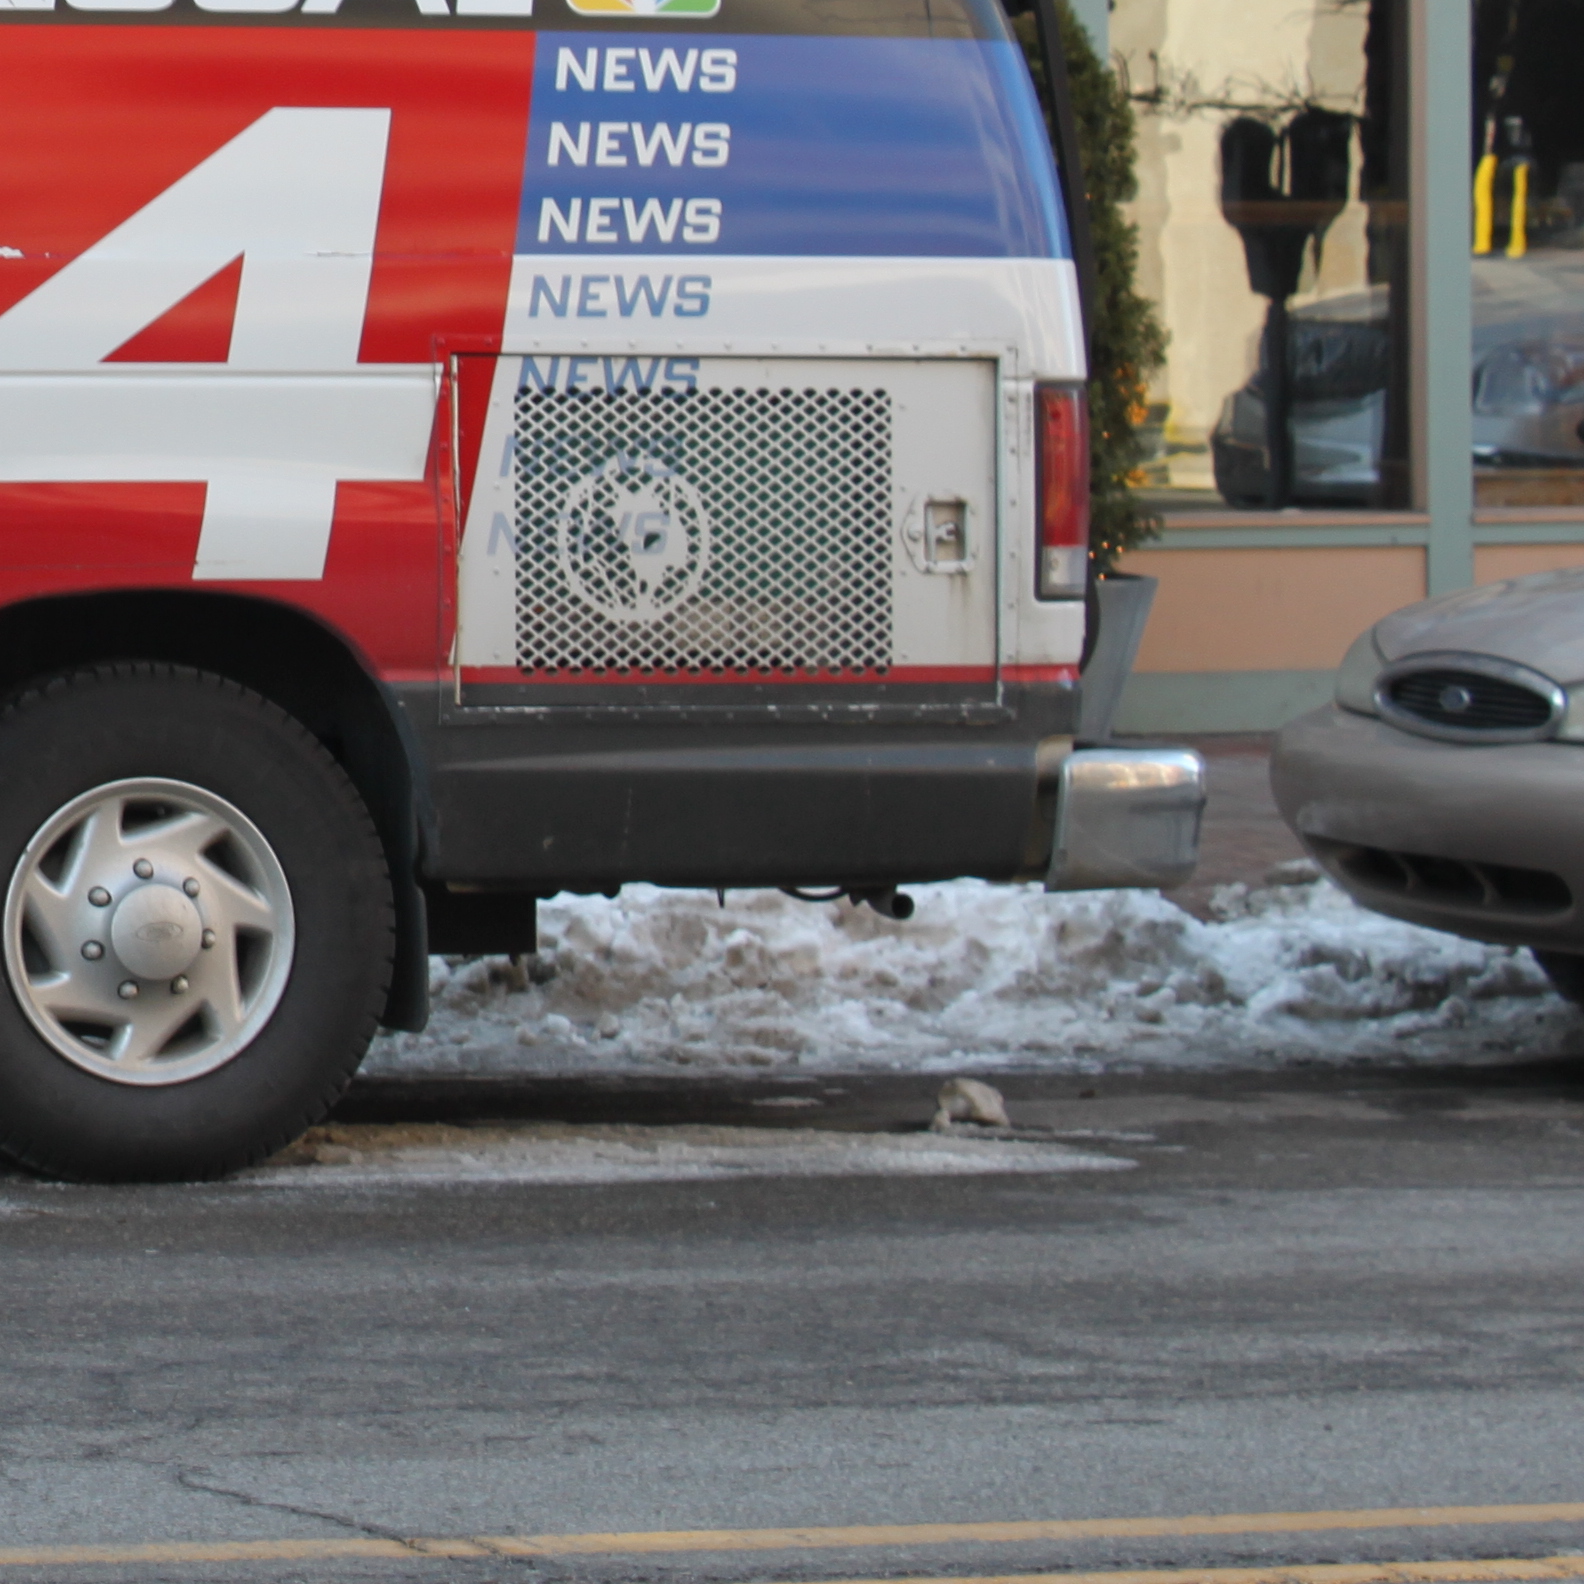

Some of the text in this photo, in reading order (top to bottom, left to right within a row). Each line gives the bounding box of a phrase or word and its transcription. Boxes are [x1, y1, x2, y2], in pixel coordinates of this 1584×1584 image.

[555, 46, 738, 93] NEWS
[547, 121, 731, 168] NEWS
[537, 197, 723, 243] NEWS
[529, 276, 711, 318] NEWS
[519, 357, 700, 399] NEWS
